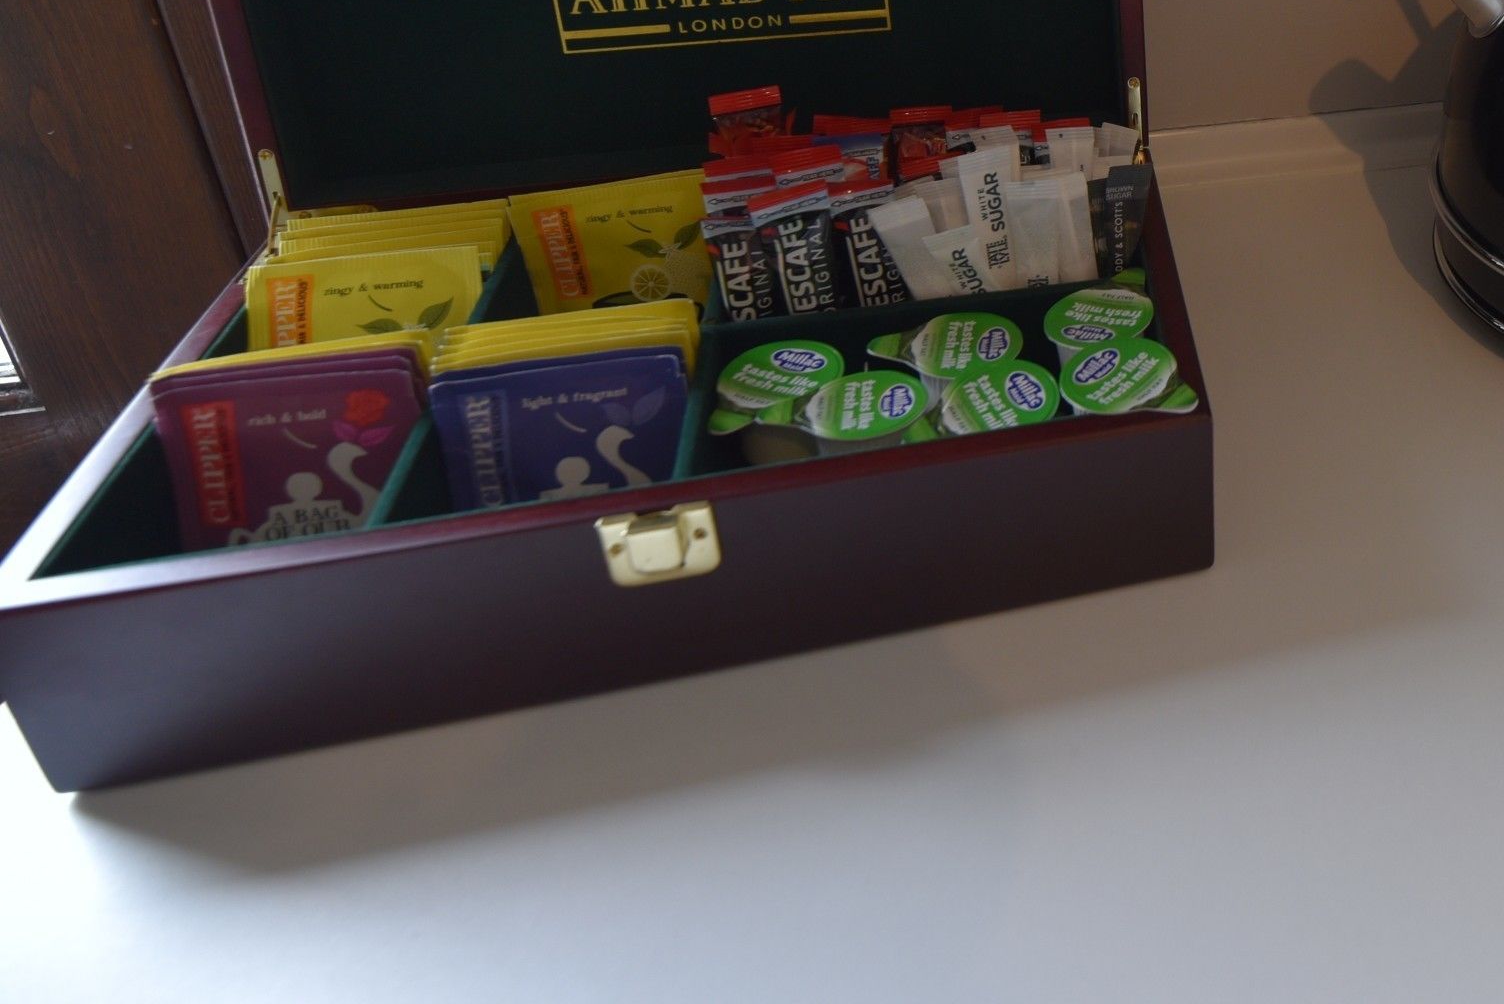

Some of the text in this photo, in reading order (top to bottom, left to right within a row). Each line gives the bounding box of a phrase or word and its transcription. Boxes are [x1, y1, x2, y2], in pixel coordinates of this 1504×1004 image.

[677, 14, 782, 34] LONDON
[616, 210, 625, 219] &
[629, 204, 673, 216] warming
[977, 189, 989, 220] WHITE
[984, 172, 1005, 232] SUGAR
[949, 262, 968, 290] WHITE
[1114, 252, 1124, 272] DDY
[323, 279, 424, 297] zingy & warming
[1065, 310, 1138, 327] tastes like
[1071, 302, 1143, 319] fresh milk
[941, 321, 963, 370] fresh milk
[955, 320, 976, 370] tastes like
[731, 371, 809, 397] fresh milk
[742, 363, 819, 388] tastes like
[1085, 371, 1128, 400] tastes
[1121, 351, 1149, 373] like
[1097, 380, 1135, 406] fresh
[1130, 356, 1160, 382] milk
[557, 393, 569, 404] &
[573, 387, 628, 403] fragrant
[841, 381, 861, 431] fresh milk
[857, 379, 877, 430] tastes like
[963, 381, 990, 414] fresh
[976, 374, 1006, 412] tastes
[280, 412, 292, 424] &
[297, 409, 327, 421] bold
[465, 395, 504, 506] CLIPPER
[191, 407, 232, 524] CLIPPER
[274, 505, 339, 526] A BAG
